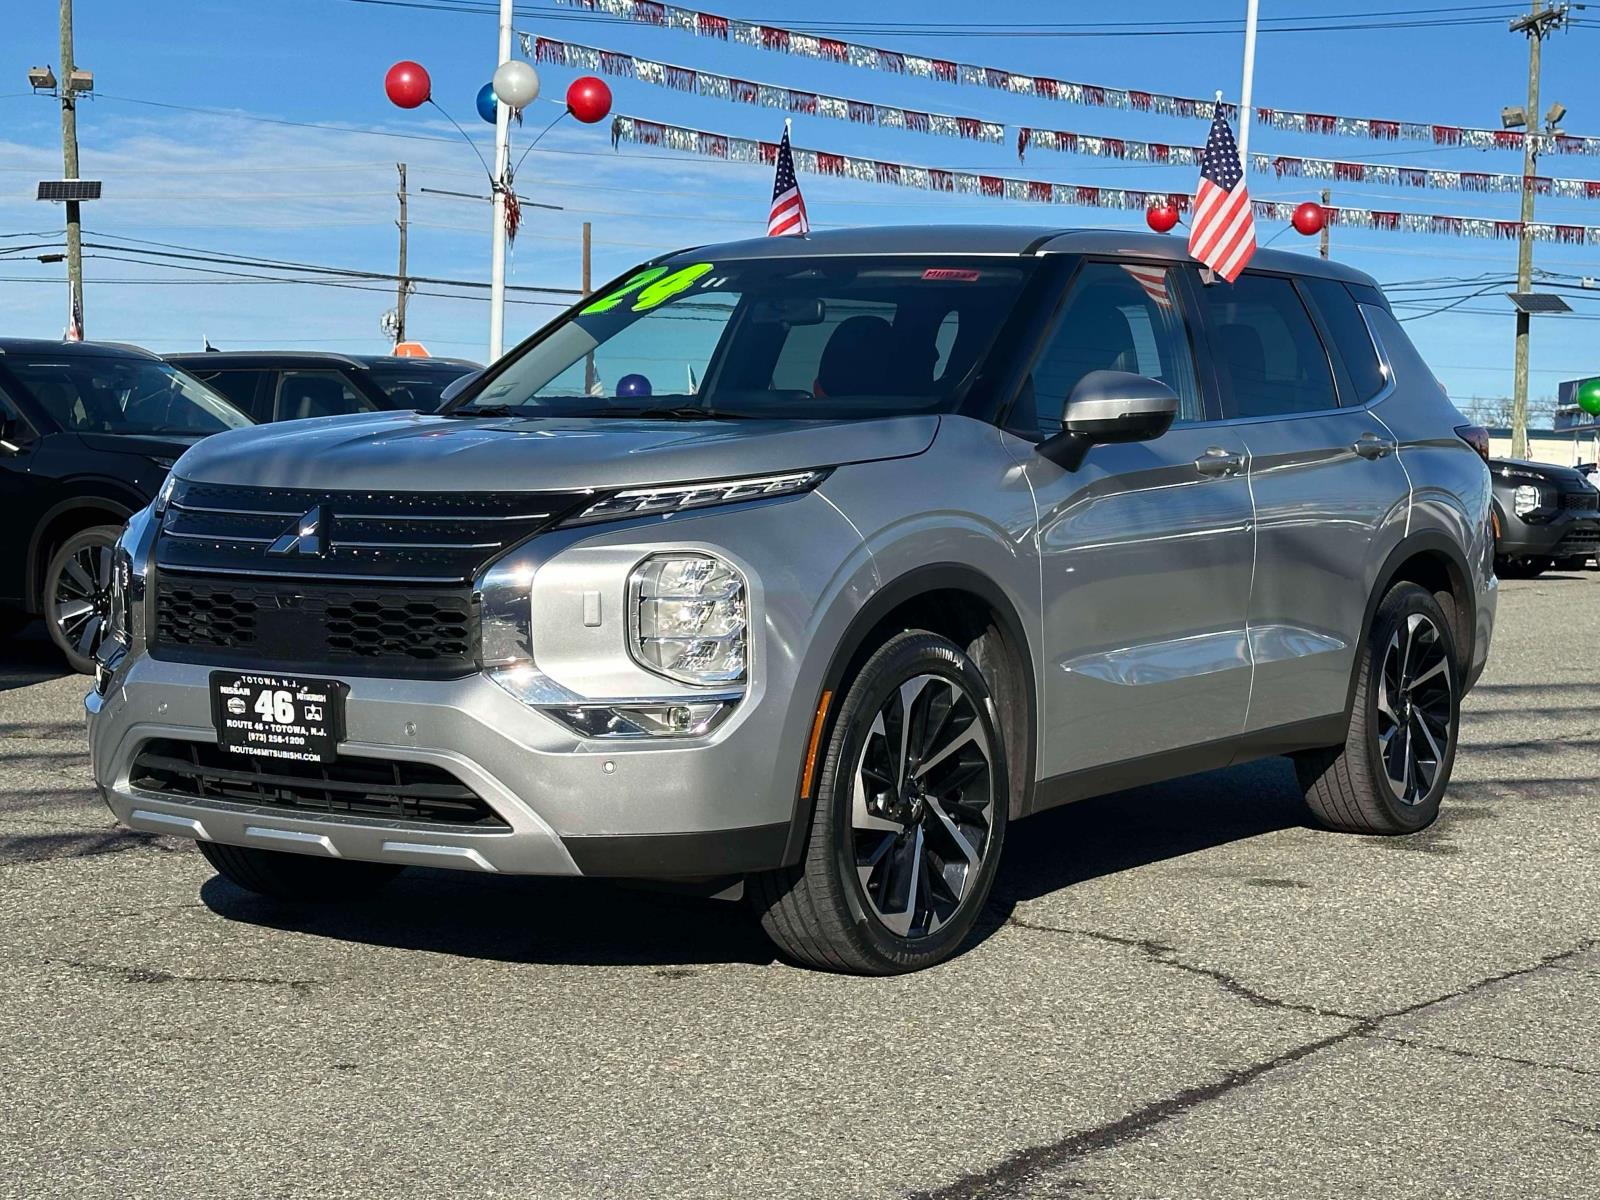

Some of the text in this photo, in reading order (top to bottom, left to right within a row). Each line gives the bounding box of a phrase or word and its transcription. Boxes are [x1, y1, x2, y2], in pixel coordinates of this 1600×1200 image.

[579, 263, 714, 316] 24
[241, 675, 300, 688] TOTOWA, N.J.
[220, 686, 251, 696] NISSAN
[254, 690, 295, 724] 46
[227, 719, 327, 737] ROUTE 46 TOTOWA, N.J.
[248, 733, 267, 744] (973)
[230, 745, 321, 762] ROUTE46MITSUBISHI.COM
